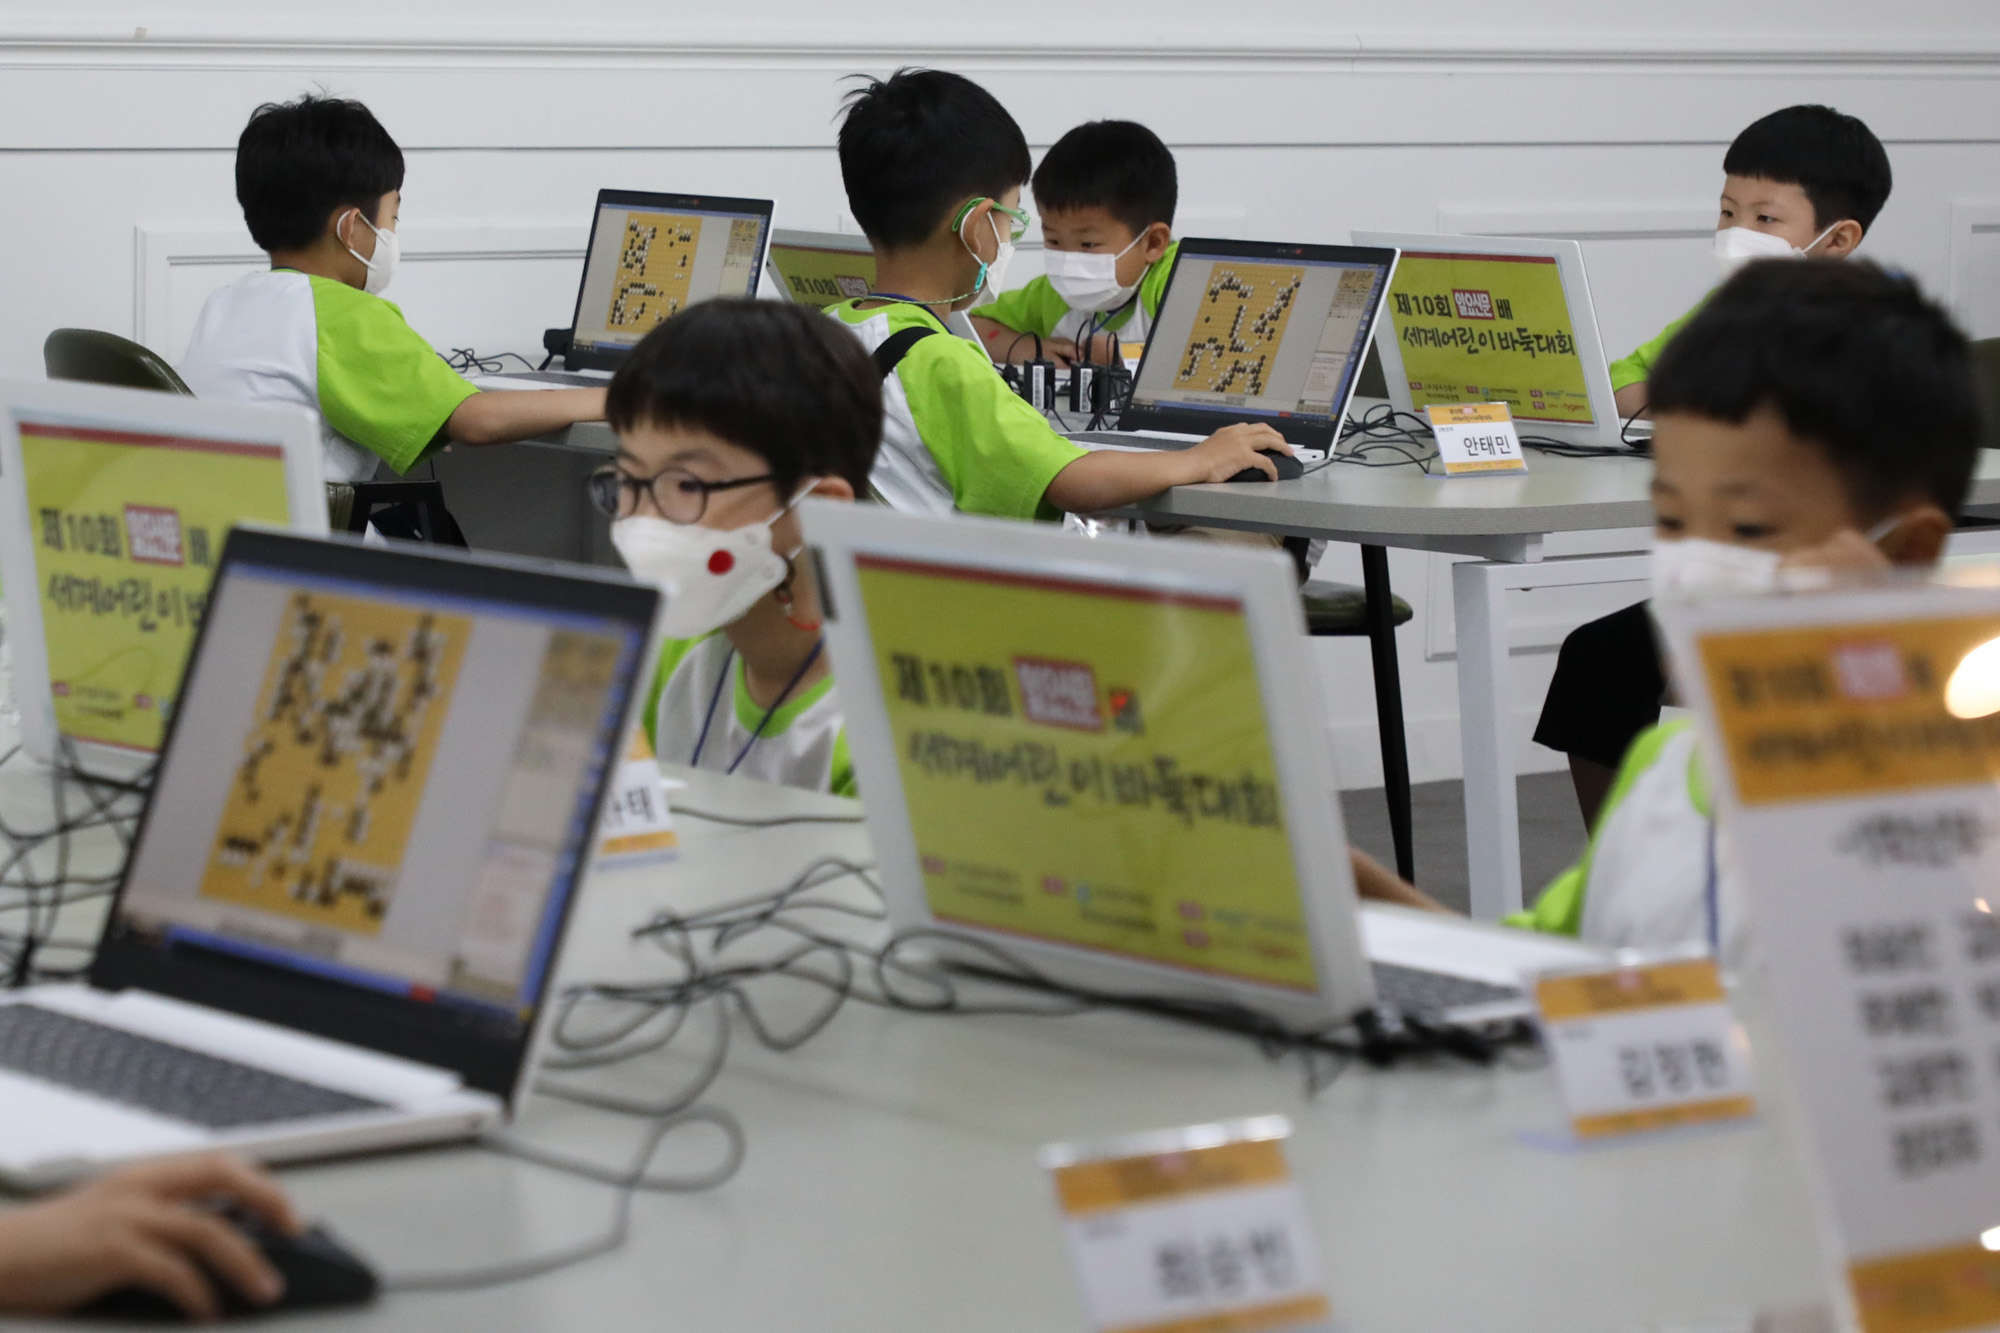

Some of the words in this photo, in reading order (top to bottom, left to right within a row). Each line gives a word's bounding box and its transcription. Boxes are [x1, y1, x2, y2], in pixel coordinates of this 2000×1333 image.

[1394, 292, 1453, 318] 제10회
[1454, 291, 1493, 318] 일요신문
[1496, 299, 1514, 320] 배
[1463, 435, 1512, 456] 안태민
